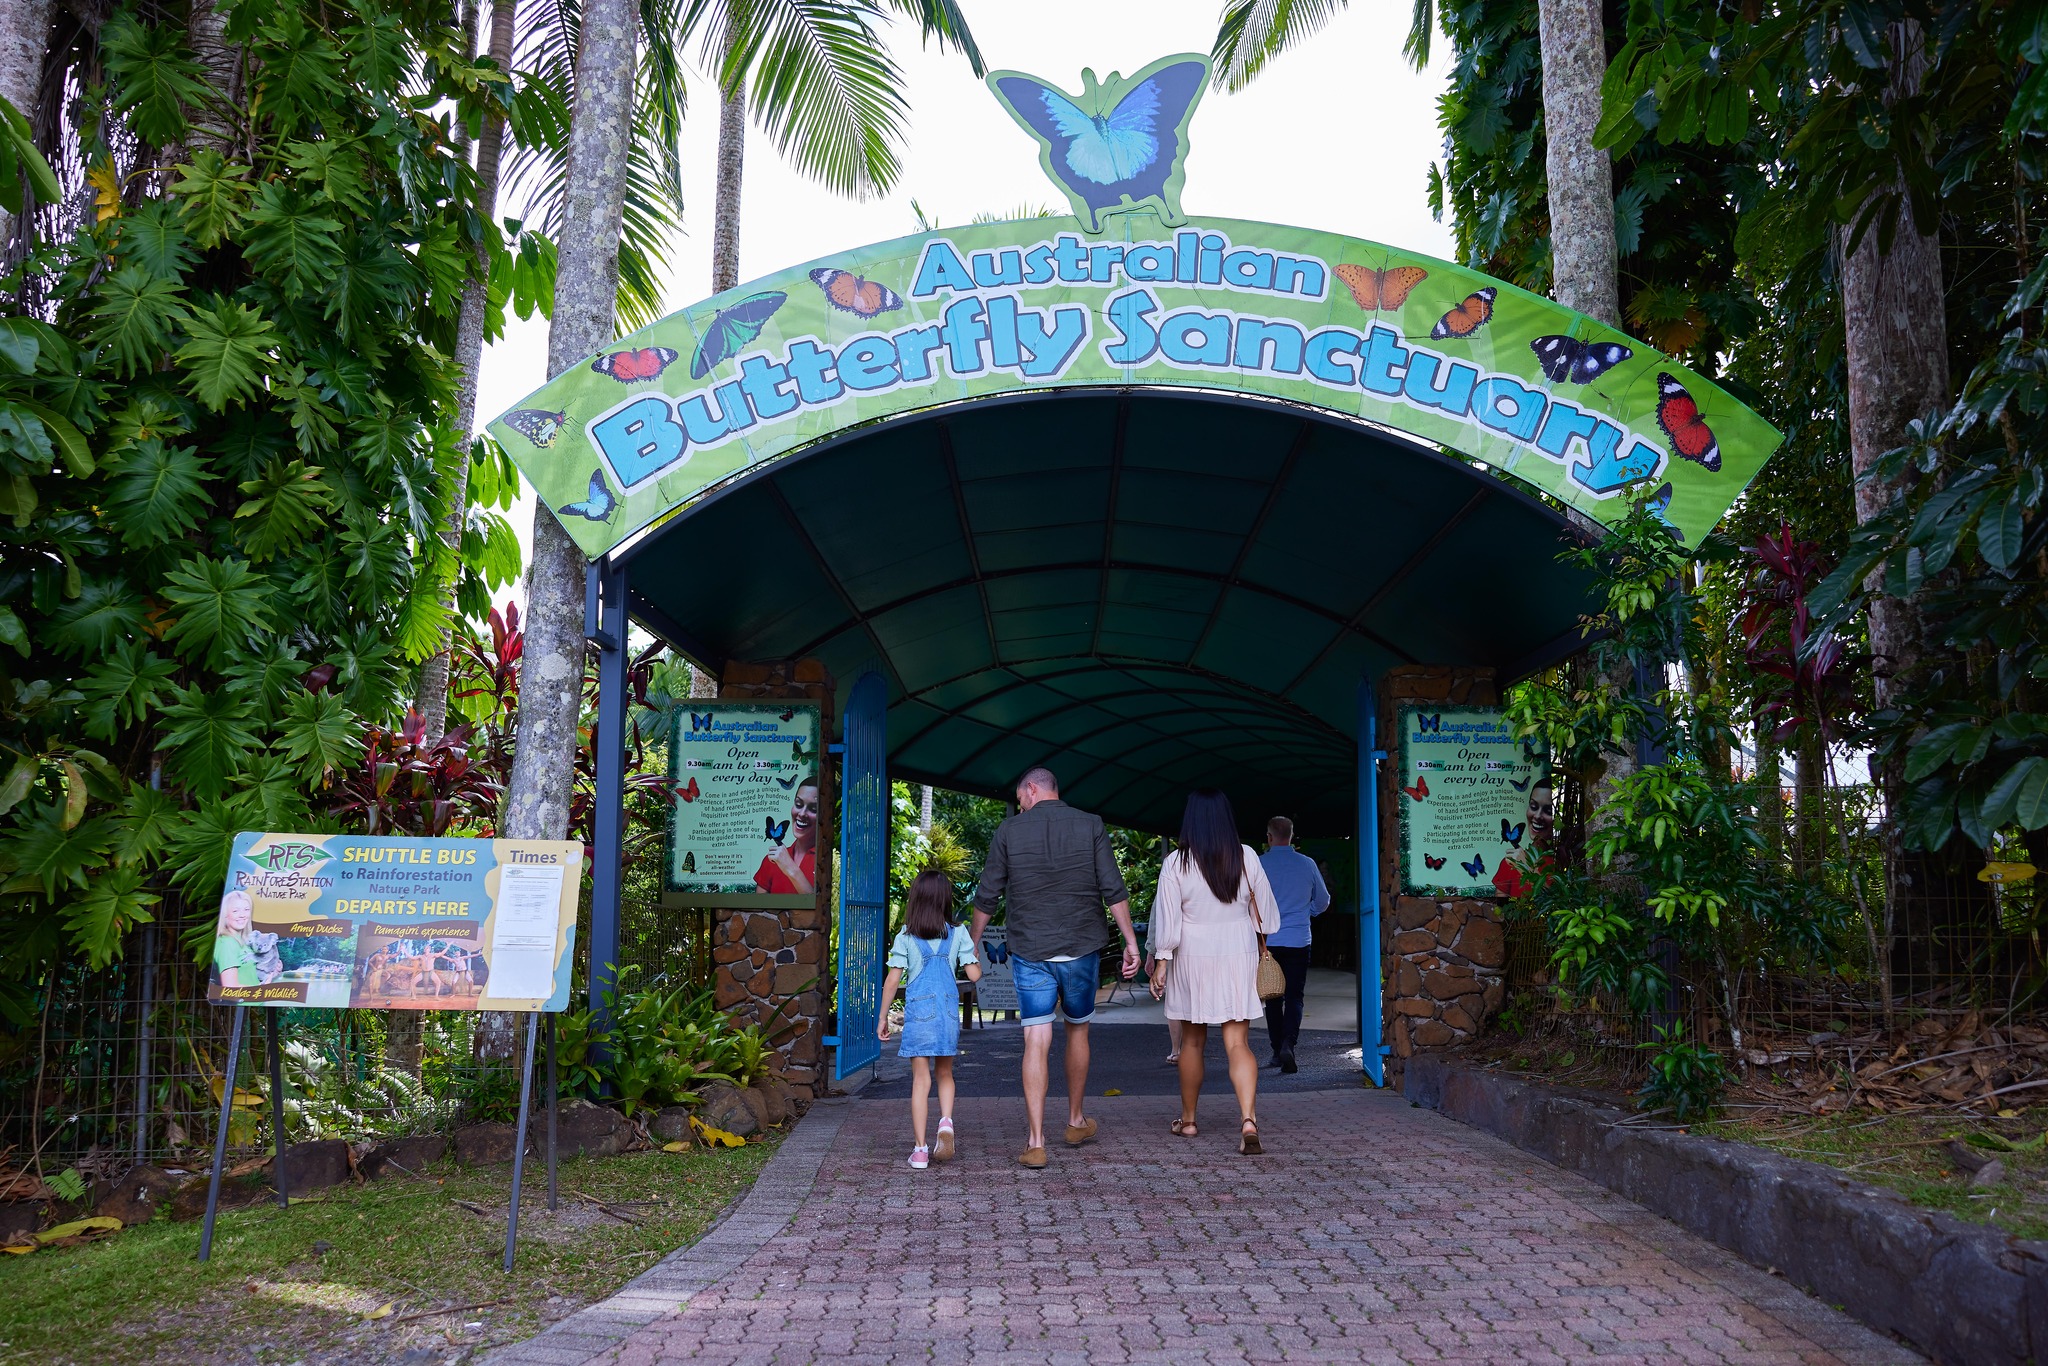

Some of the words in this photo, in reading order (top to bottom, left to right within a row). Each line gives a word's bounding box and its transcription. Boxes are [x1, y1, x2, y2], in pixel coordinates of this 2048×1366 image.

[911, 231, 1326, 298] Australian
[592, 294, 1086, 488] Butterfly
[1104, 289, 1662, 491] Sanctuary
[712, 720, 778, 731] Australian
[1440, 721, 1507, 732] Australian
[684, 732, 741, 744] Butterfly
[743, 732, 807, 744] Sanctuary
[1412, 732, 1470, 745] Butterfly
[727, 747, 759, 760] Open
[1457, 748, 1490, 761] Open
[737, 761, 749, 770] to
[1468, 762, 1480, 771] to
[1511, 765, 1532, 775] pm
[712, 774, 744, 785] every
[748, 771, 773, 785] day
[1443, 776, 1477, 787] every
[1480, 773, 1505, 787] day
[721, 790, 727, 798] in
[740, 788, 755, 796] enjoy
[725, 794, 756, 804] surrounded
[765, 792, 791, 801] hundreds
[1473, 790, 1488, 798] enjoy
[747, 801, 768, 809] friendly
[1459, 796, 1490, 806] surrounded
[1499, 795, 1525, 803] hundreds
[1481, 802, 1502, 811] friendly
[701, 811, 729, 819] inquisitive
[730, 808, 750, 817] tropical
[1434, 813, 1463, 821] inquisitive
[1464, 810, 1486, 819] tropical
[730, 820, 747, 828] option
[1465, 822, 1482, 830] option
[692, 828, 726, 836] participating
[716, 833, 734, 841] guided
[1451, 836, 1470, 844] guided
[268, 844, 315, 870] RFS
[343, 847, 432, 864] SHUTTLE
[437, 849, 477, 865] BUS
[510, 850, 557, 864] Times
[341, 870, 354, 879] to
[357, 867, 473, 882] Rainforestation
[369, 883, 410, 894] Nature
[413, 884, 440, 895] Park
[335, 899, 417, 915] DEPARTS
[422, 901, 469, 916] HERE
[290, 923, 315, 937] Army
[316, 924, 343, 933] Ducks
[374, 925, 419, 937] Pamagirri
[421, 926, 470, 937] experience
[220, 987, 251, 997] Koalas
[252, 987, 262, 999] &
[263, 987, 299, 998] Wildlife
